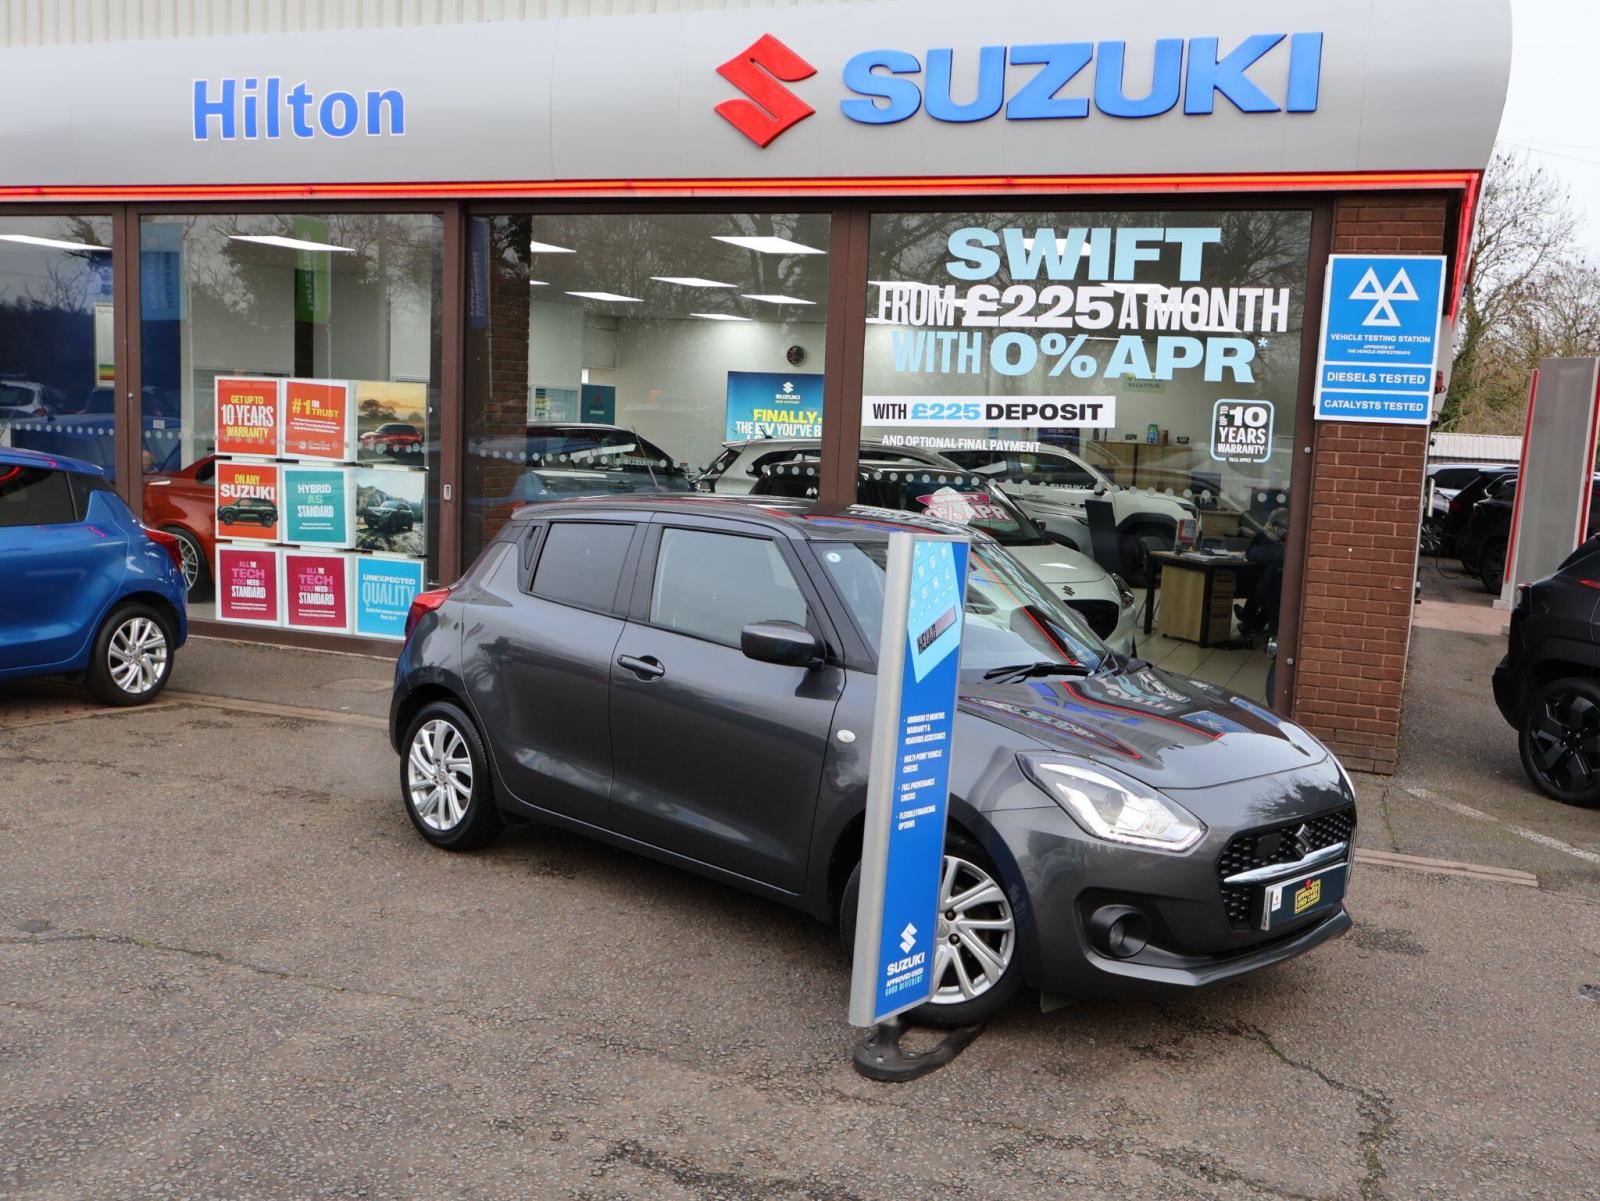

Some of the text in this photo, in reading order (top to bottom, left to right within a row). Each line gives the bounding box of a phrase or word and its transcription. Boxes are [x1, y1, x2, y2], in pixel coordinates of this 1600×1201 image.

[839, 32, 1325, 125] SUZUKI
[193, 76, 406, 141] Hilton
[946, 227, 1221, 281] SWIFT
[878, 285, 1289, 333] FROM £225 A MONTH
[1331, 334, 1430, 343] VEHICLE TESTING STATION
[890, 330, 982, 375] WITH
[990, 333, 1097, 378] 0%
[1327, 372, 1426, 385] DIESELS TESTED
[230, 395, 264, 405] GET UP TO
[291, 398, 311, 415] #1
[1324, 399, 1424, 412] CATALYSTS TESTED
[221, 404, 235, 426] 10
[236, 405, 274, 427] YEARS
[311, 408, 339, 418] TRUST
[873, 403, 1103, 421] WITH £225 DEPOSIT
[1229, 406, 1268, 427] 10
[227, 426, 269, 439] WARRANTY
[735, 421, 753, 434] THE
[755, 422, 776, 436] EV
[777, 423, 812, 437] YOU'VE
[1219, 427, 1266, 445] YEARS
[882, 435, 1041, 453] AND OPTIONAL FINAL PAYMENT
[1217, 443, 1265, 455] WARRANTY
[234, 474, 261, 485] ON ANY
[220, 483, 276, 500] SUZUKI
[297, 484, 332, 494] HYBRID
[307, 495, 323, 505] AS
[297, 505, 334, 518] STANDARD
[231, 568, 265, 578] TECH
[298, 574, 334, 585] TECH
[362, 574, 416, 585] UNEXPECTED
[231, 585, 266, 599] STANDARD
[298, 592, 335, 606] STANDARD
[362, 582, 415, 608] QUALITY
[887, 952, 925, 976] SUZUKI
